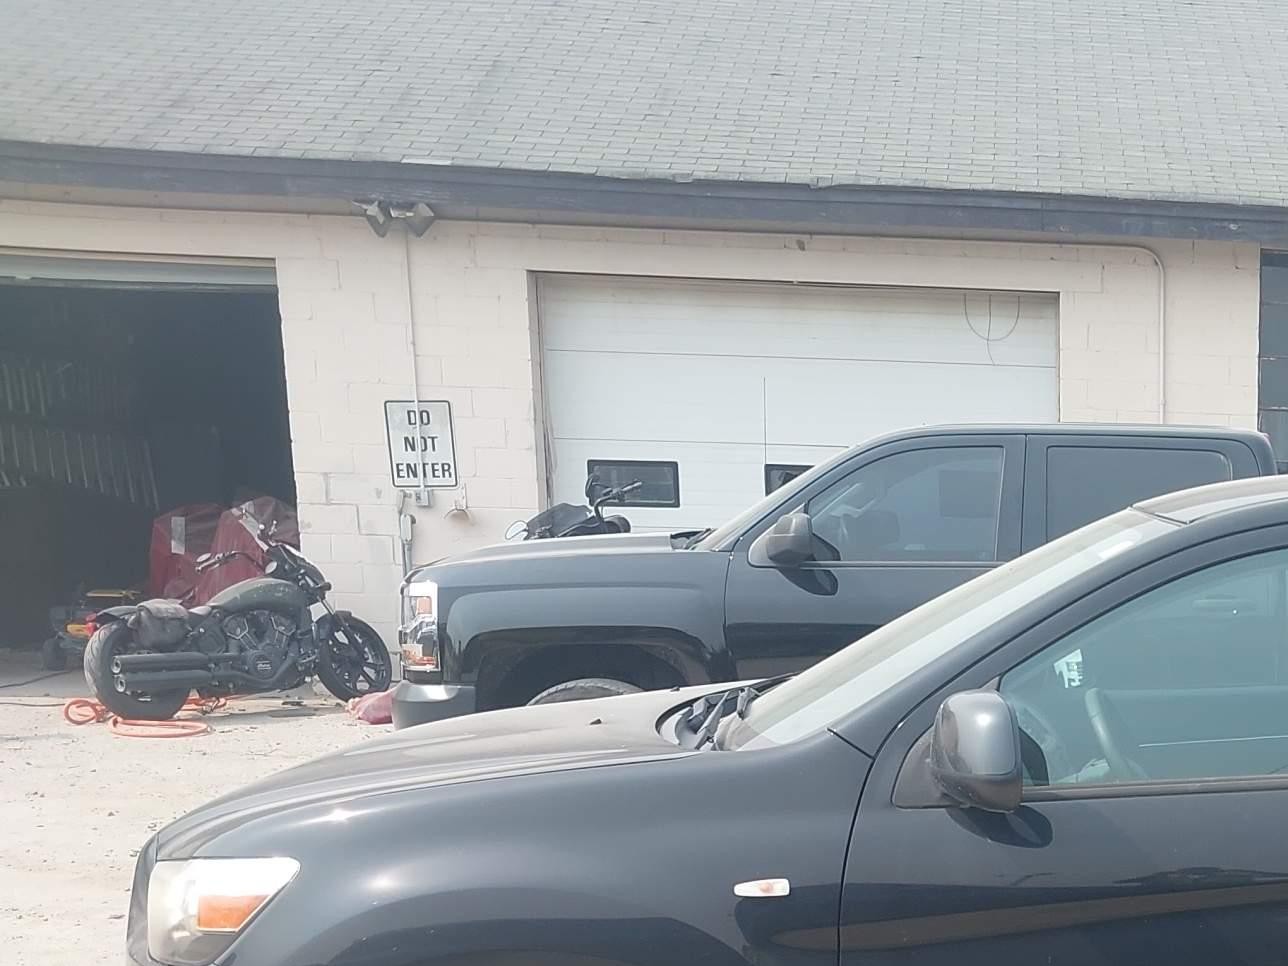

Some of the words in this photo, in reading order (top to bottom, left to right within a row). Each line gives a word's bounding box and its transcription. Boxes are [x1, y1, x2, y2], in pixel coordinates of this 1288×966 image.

[406, 409, 431, 426] DO
[403, 436, 438, 452] NOT
[395, 462, 452, 479] ENTER
